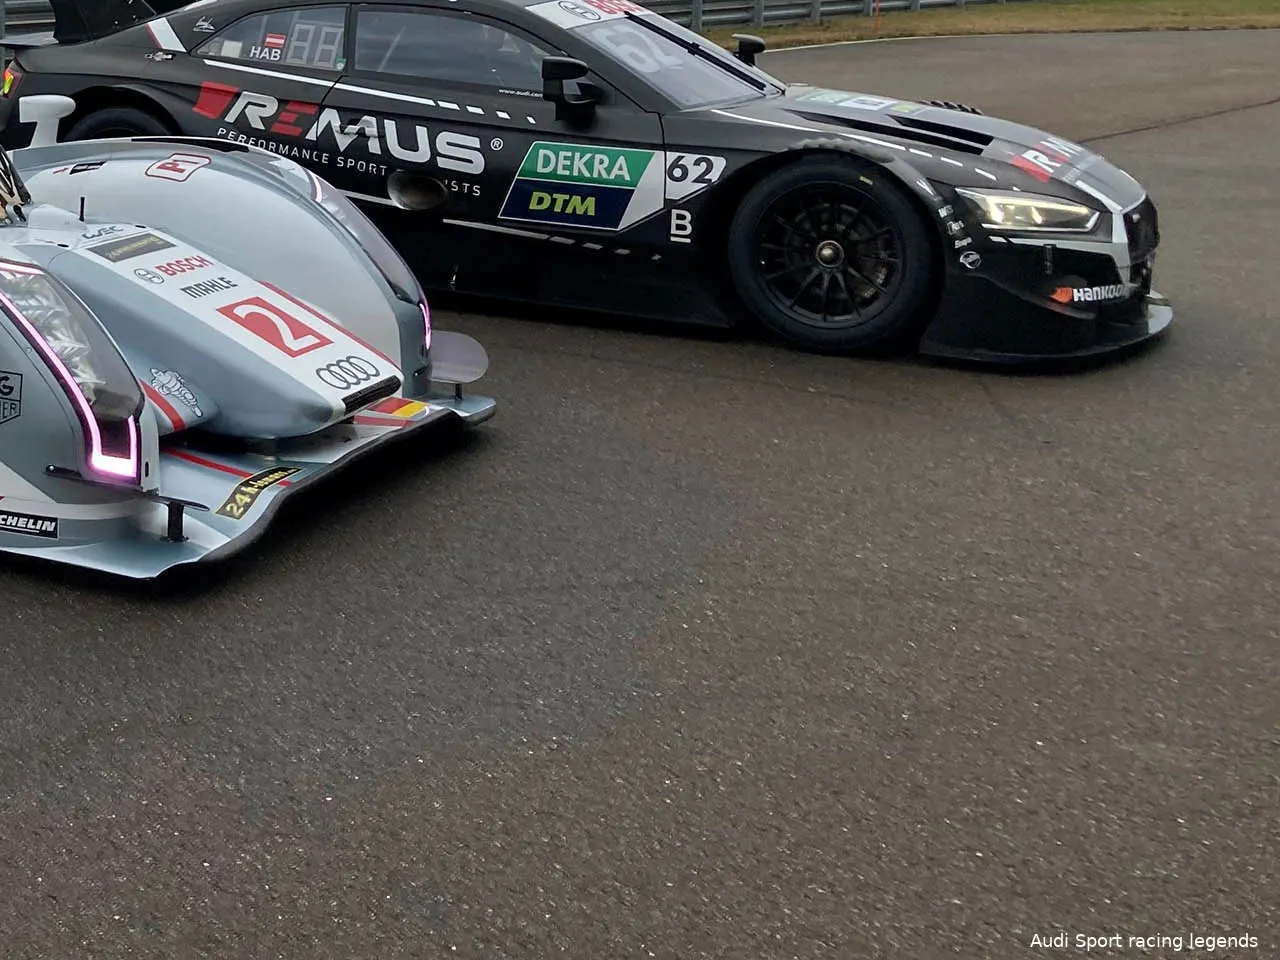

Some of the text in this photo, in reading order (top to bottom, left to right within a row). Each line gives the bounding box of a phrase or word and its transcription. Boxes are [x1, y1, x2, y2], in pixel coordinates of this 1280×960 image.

[250, 45, 281, 61] HAB
[224, 91, 486, 175] REMUS
[216, 127, 388, 175] PERFORMANCE SPORT
[536, 149, 631, 181] DEKRA
[668, 155, 714, 184] 62
[528, 191, 596, 216] DTM
[670, 208, 693, 237] B
[155, 255, 214, 276] BOSCH
[179, 277, 239, 299] MAHLE
[233, 304, 320, 352] 2
[226, 493, 252, 516] 24
